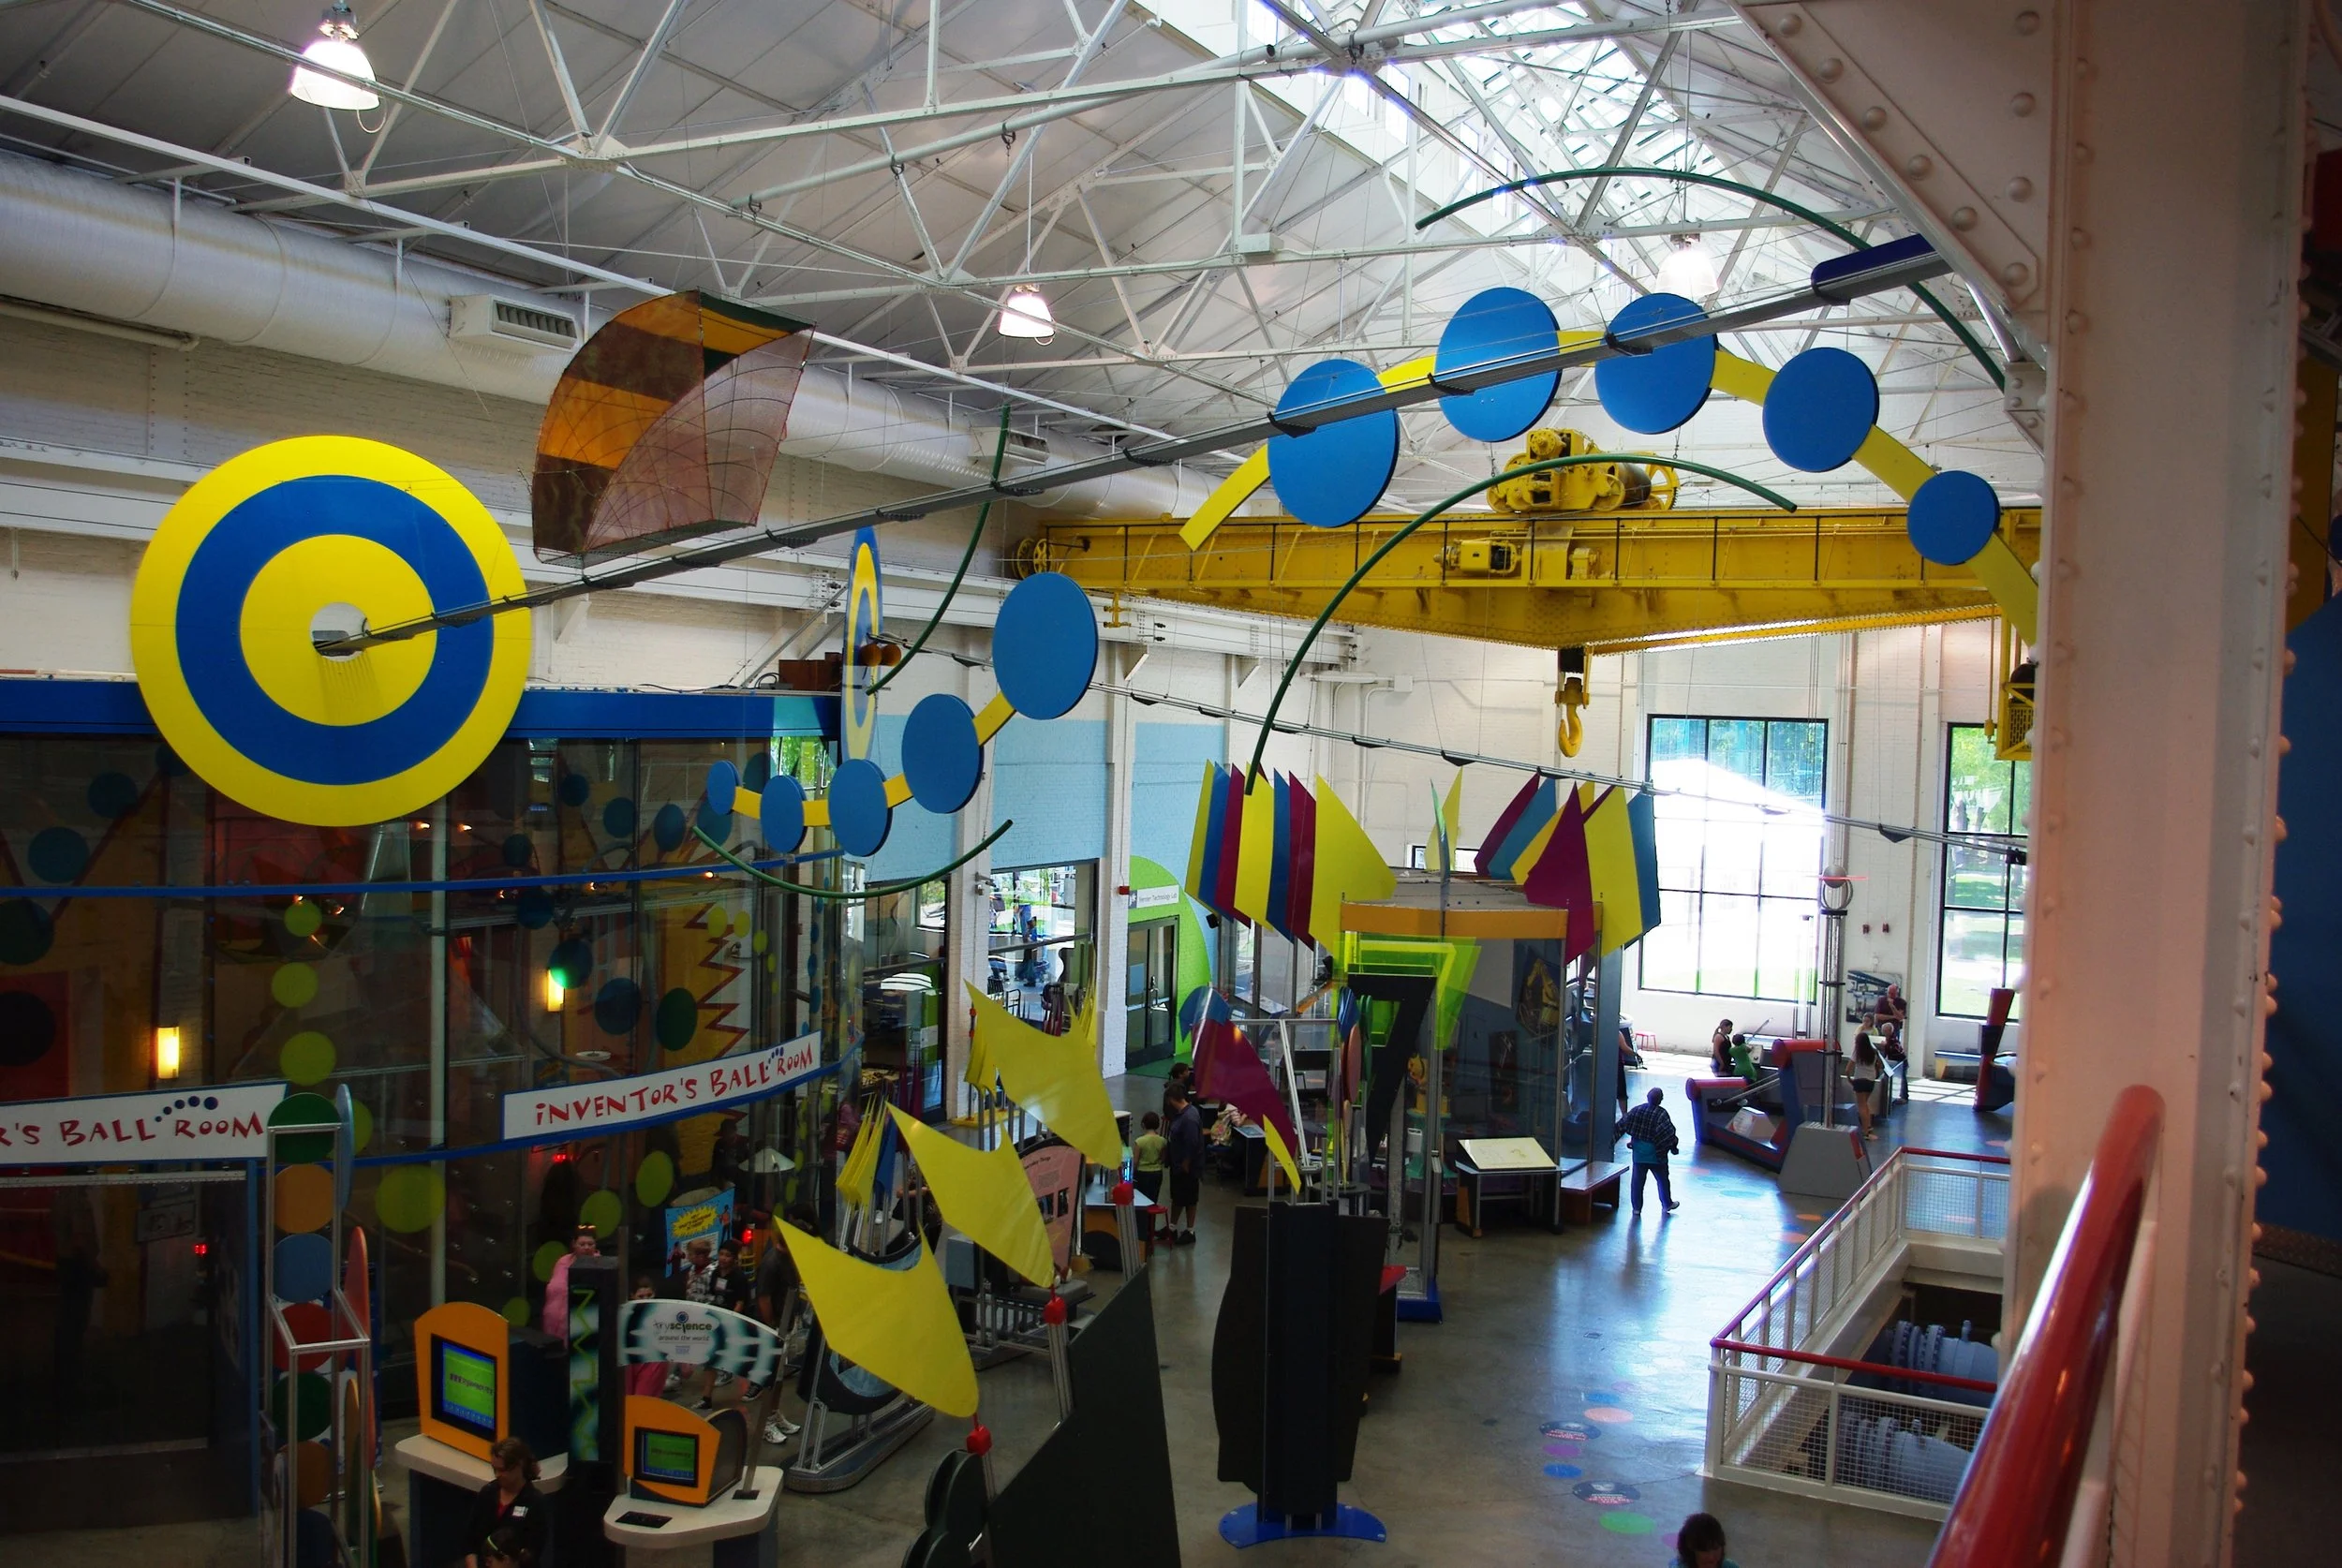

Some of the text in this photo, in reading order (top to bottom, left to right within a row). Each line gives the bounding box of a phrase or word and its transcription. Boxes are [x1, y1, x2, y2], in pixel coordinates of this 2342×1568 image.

[710, 1061, 770, 1097] BALL
[777, 1043, 812, 1075] ROOM
[60, 1118, 156, 1146] BALL
[175, 1112, 263, 1139] ROOM
